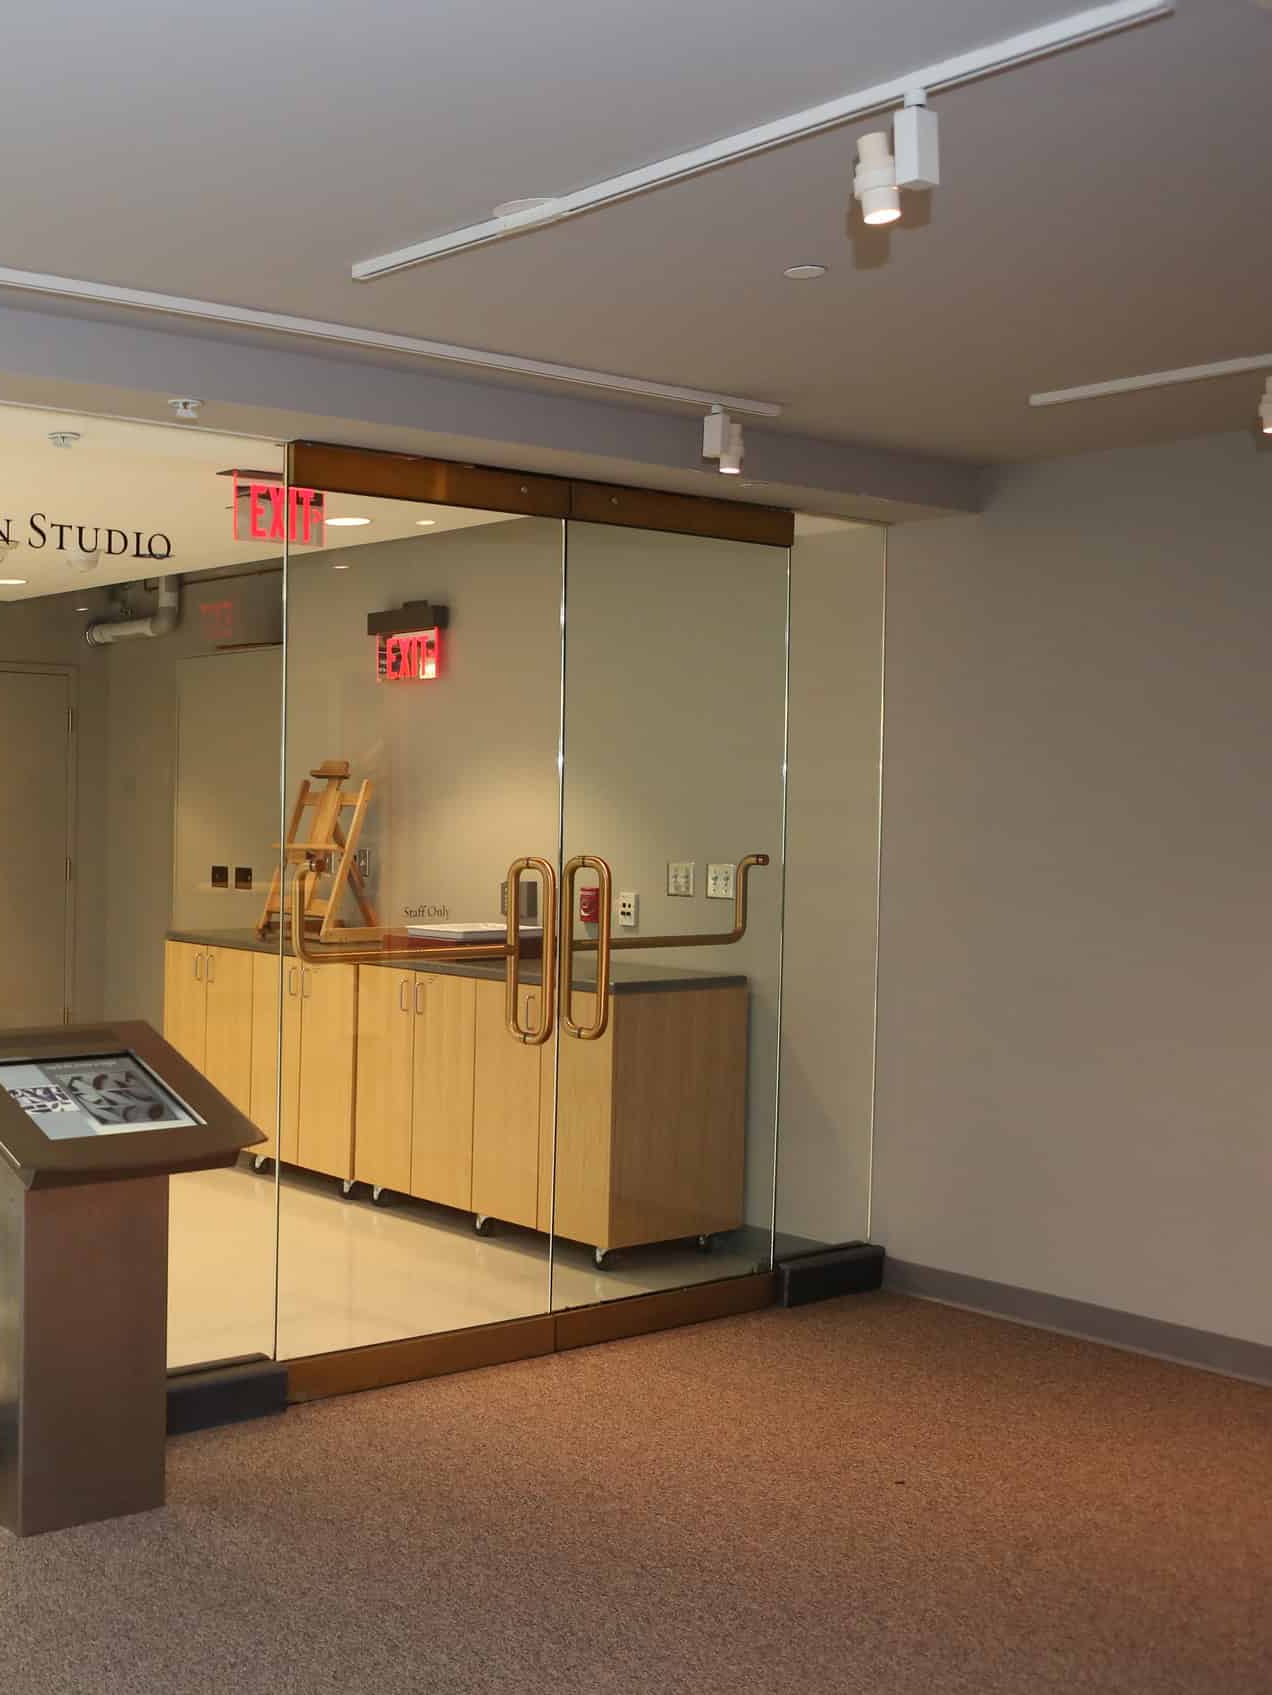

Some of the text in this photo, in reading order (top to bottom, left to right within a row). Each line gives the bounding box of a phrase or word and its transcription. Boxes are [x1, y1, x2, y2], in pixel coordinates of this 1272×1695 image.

[27, 512, 172, 560] STUDIO
[250, 484, 314, 543] EXIT
[386, 636, 429, 679] EXIT
[403, 904, 426, 919] Staff
